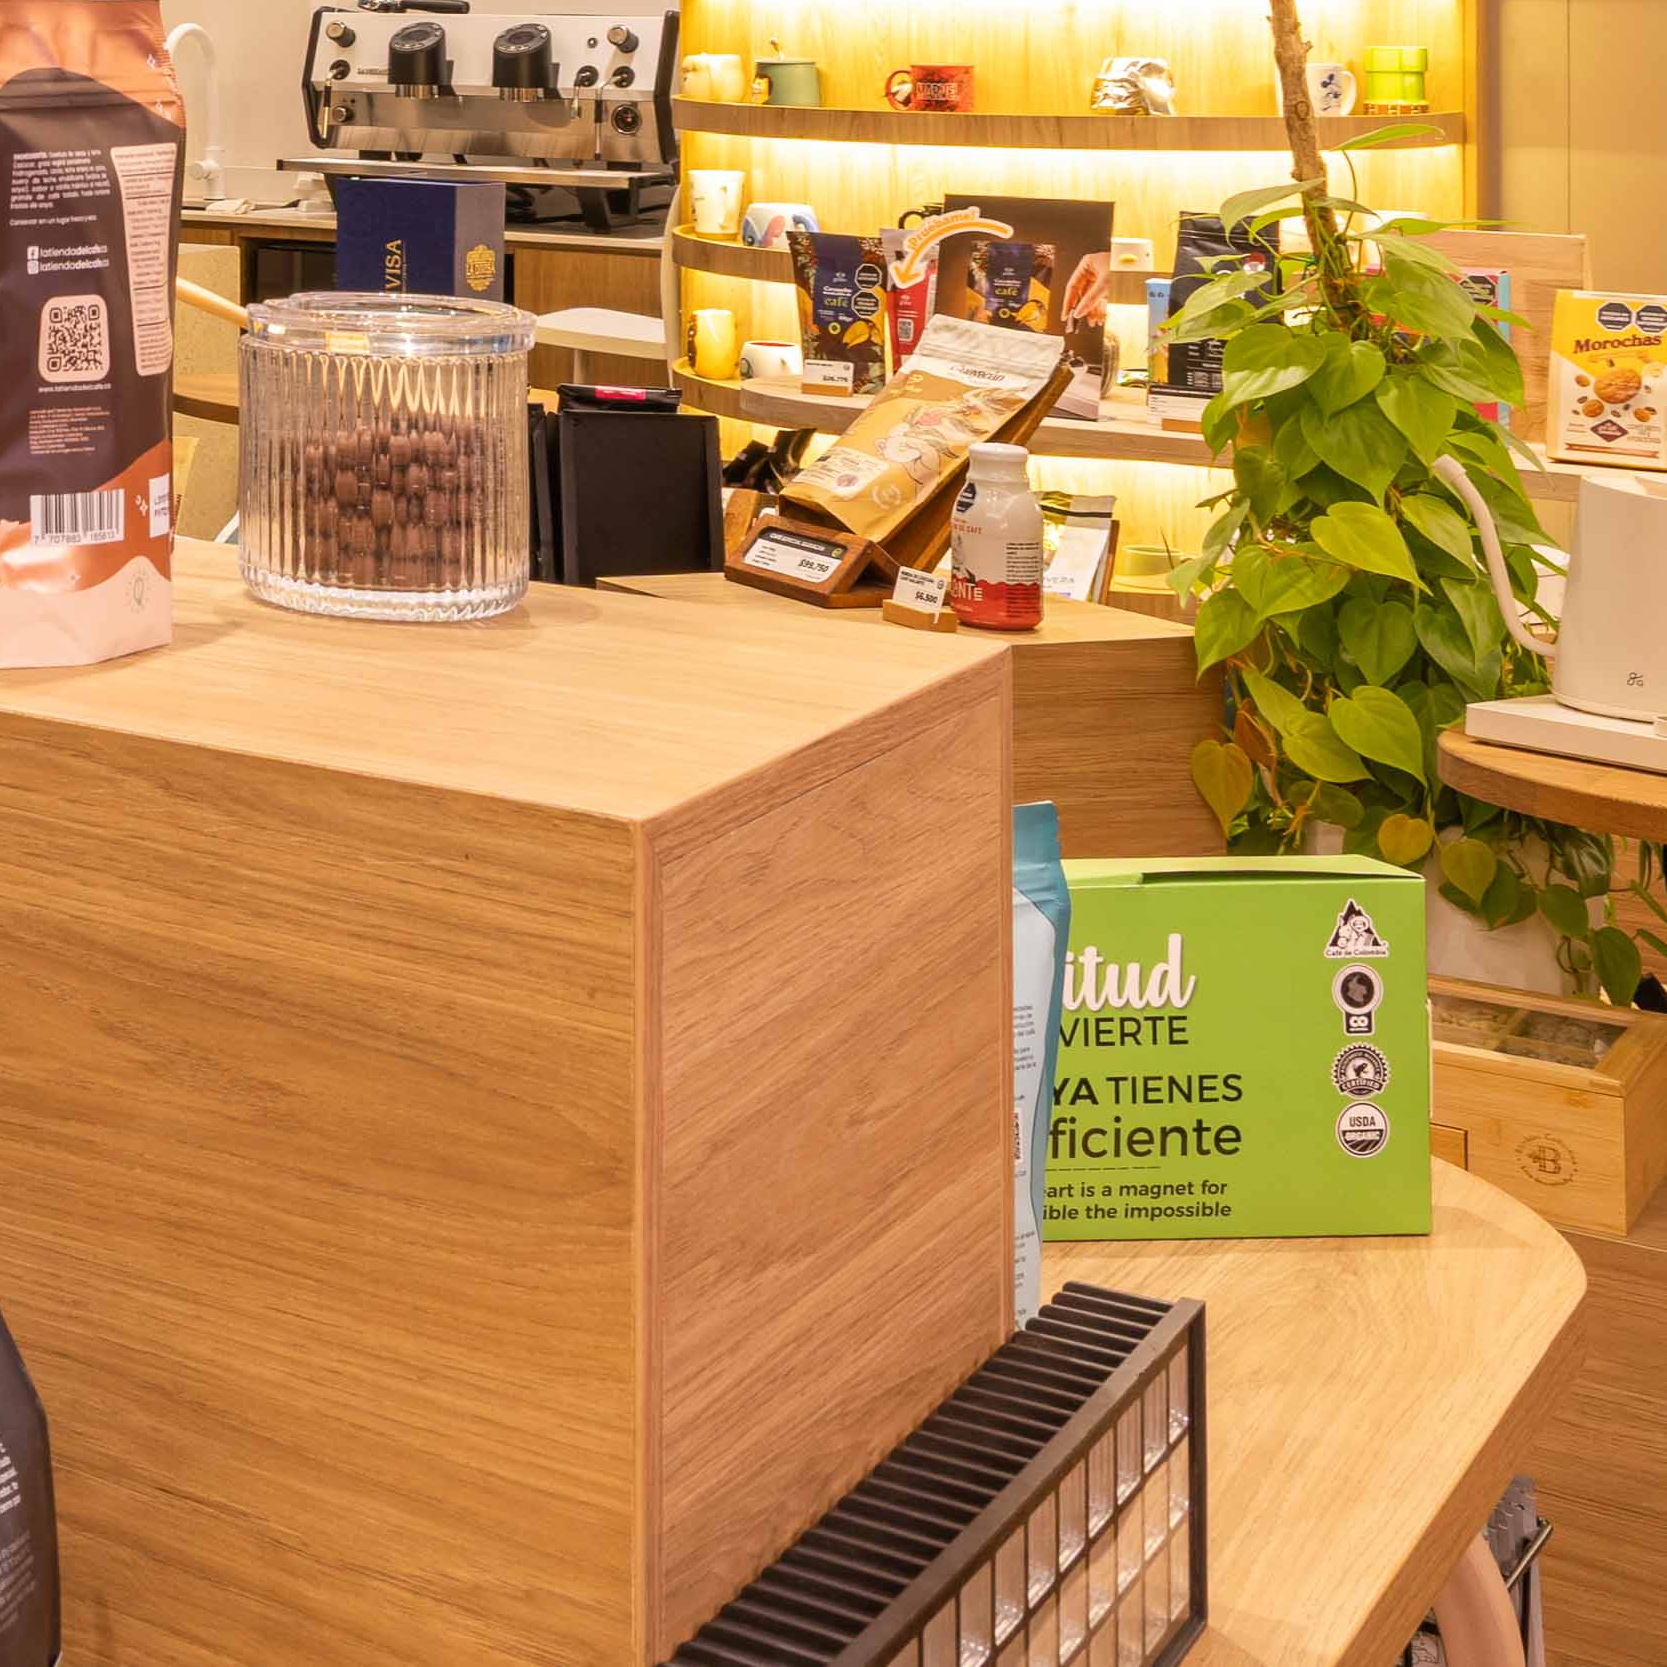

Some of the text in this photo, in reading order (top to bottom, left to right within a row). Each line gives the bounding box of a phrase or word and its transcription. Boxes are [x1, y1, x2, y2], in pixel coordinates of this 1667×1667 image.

[385, 238, 402, 290] VISA
[1573, 334, 1662, 354] Morochas
[1063, 933, 1196, 1011] itud
[1059, 1015, 1189, 1047] VIERTE
[1053, 1074, 1243, 1106] YA TIENES
[1049, 1116, 1241, 1160] ficiente
[1349, 1117, 1375, 1127] USDA
[1081, 1182, 1095, 1197] is
[1101, 1185, 1111, 1197] a
[1119, 1181, 1195, 1199] magnet
[1201, 1180, 1227, 1194] for
[1043, 1202, 1231, 1221] ible the impossible
